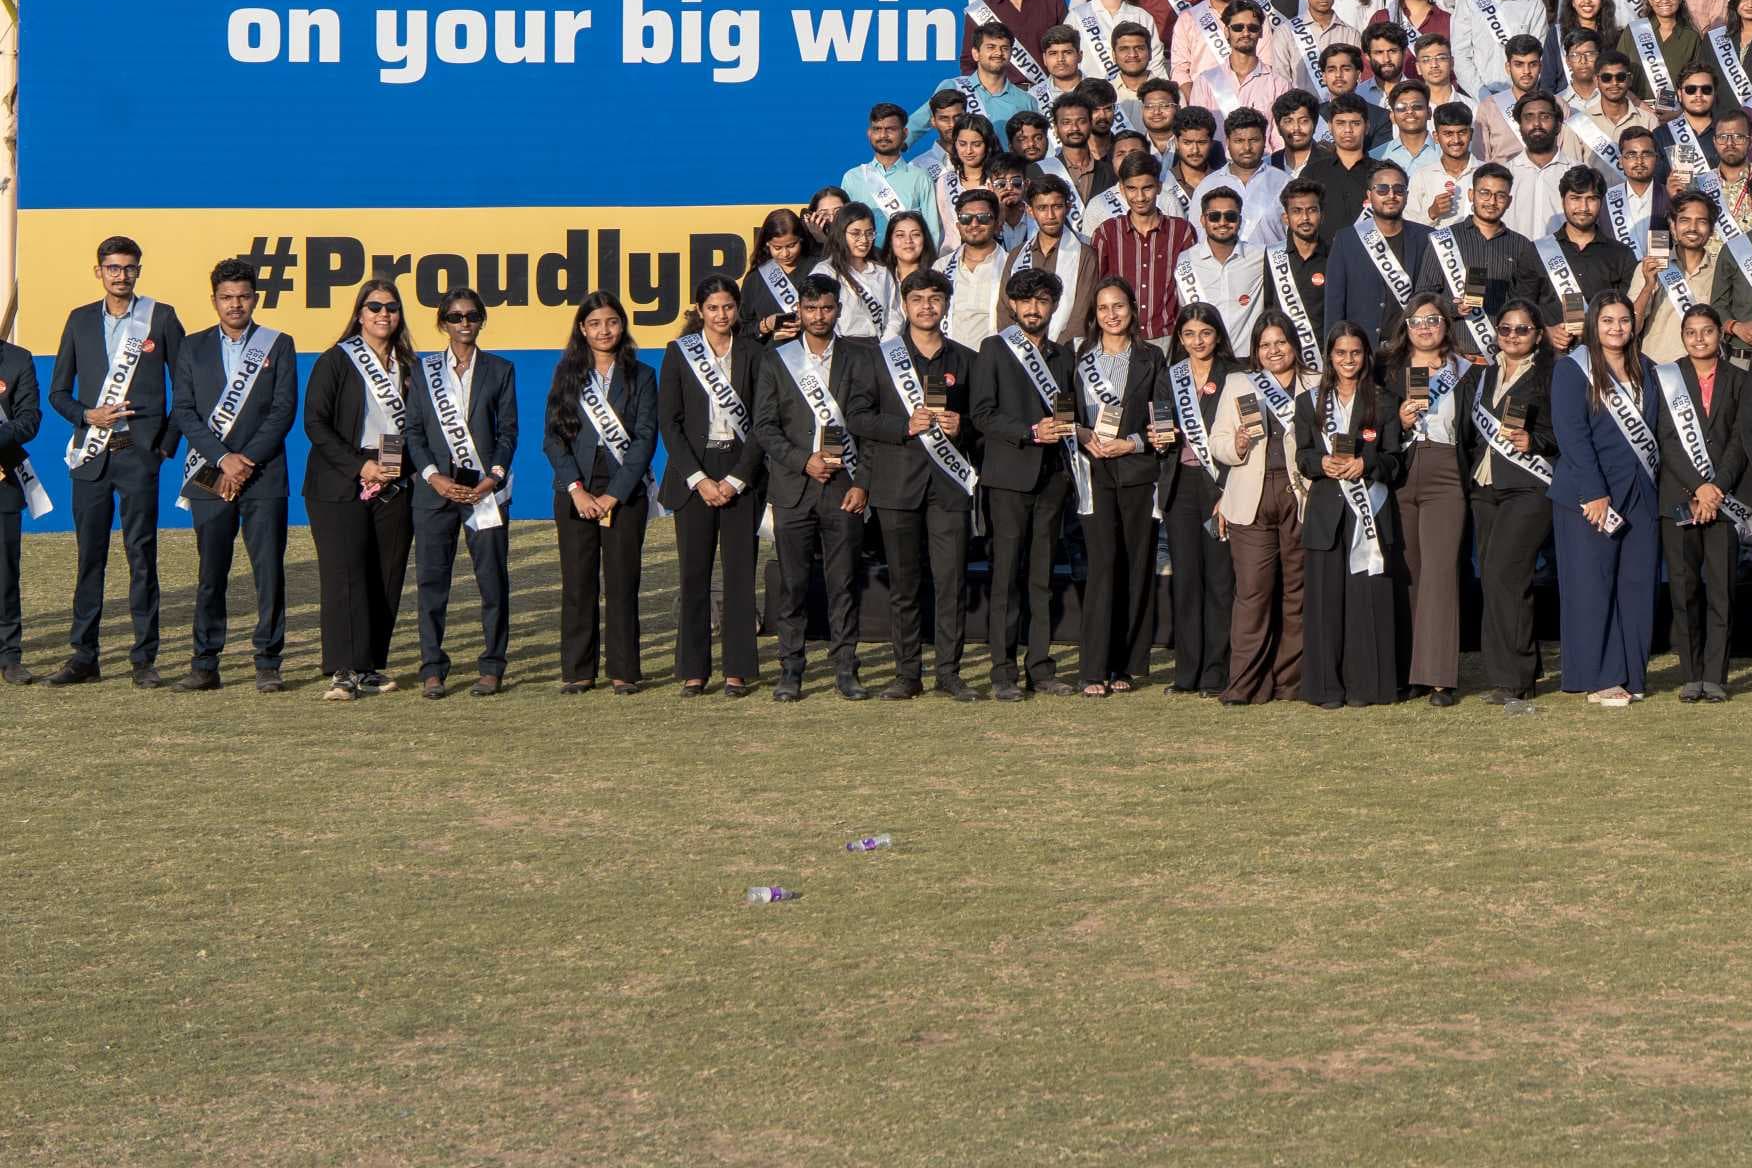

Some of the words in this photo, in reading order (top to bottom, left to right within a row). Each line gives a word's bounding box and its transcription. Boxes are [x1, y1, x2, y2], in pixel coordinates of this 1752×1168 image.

[227, 7, 341, 63] on
[376, 9, 592, 84] your
[237, 228, 750, 327] #ProudlyP
[426, 356, 475, 471] ProudlyPlac
